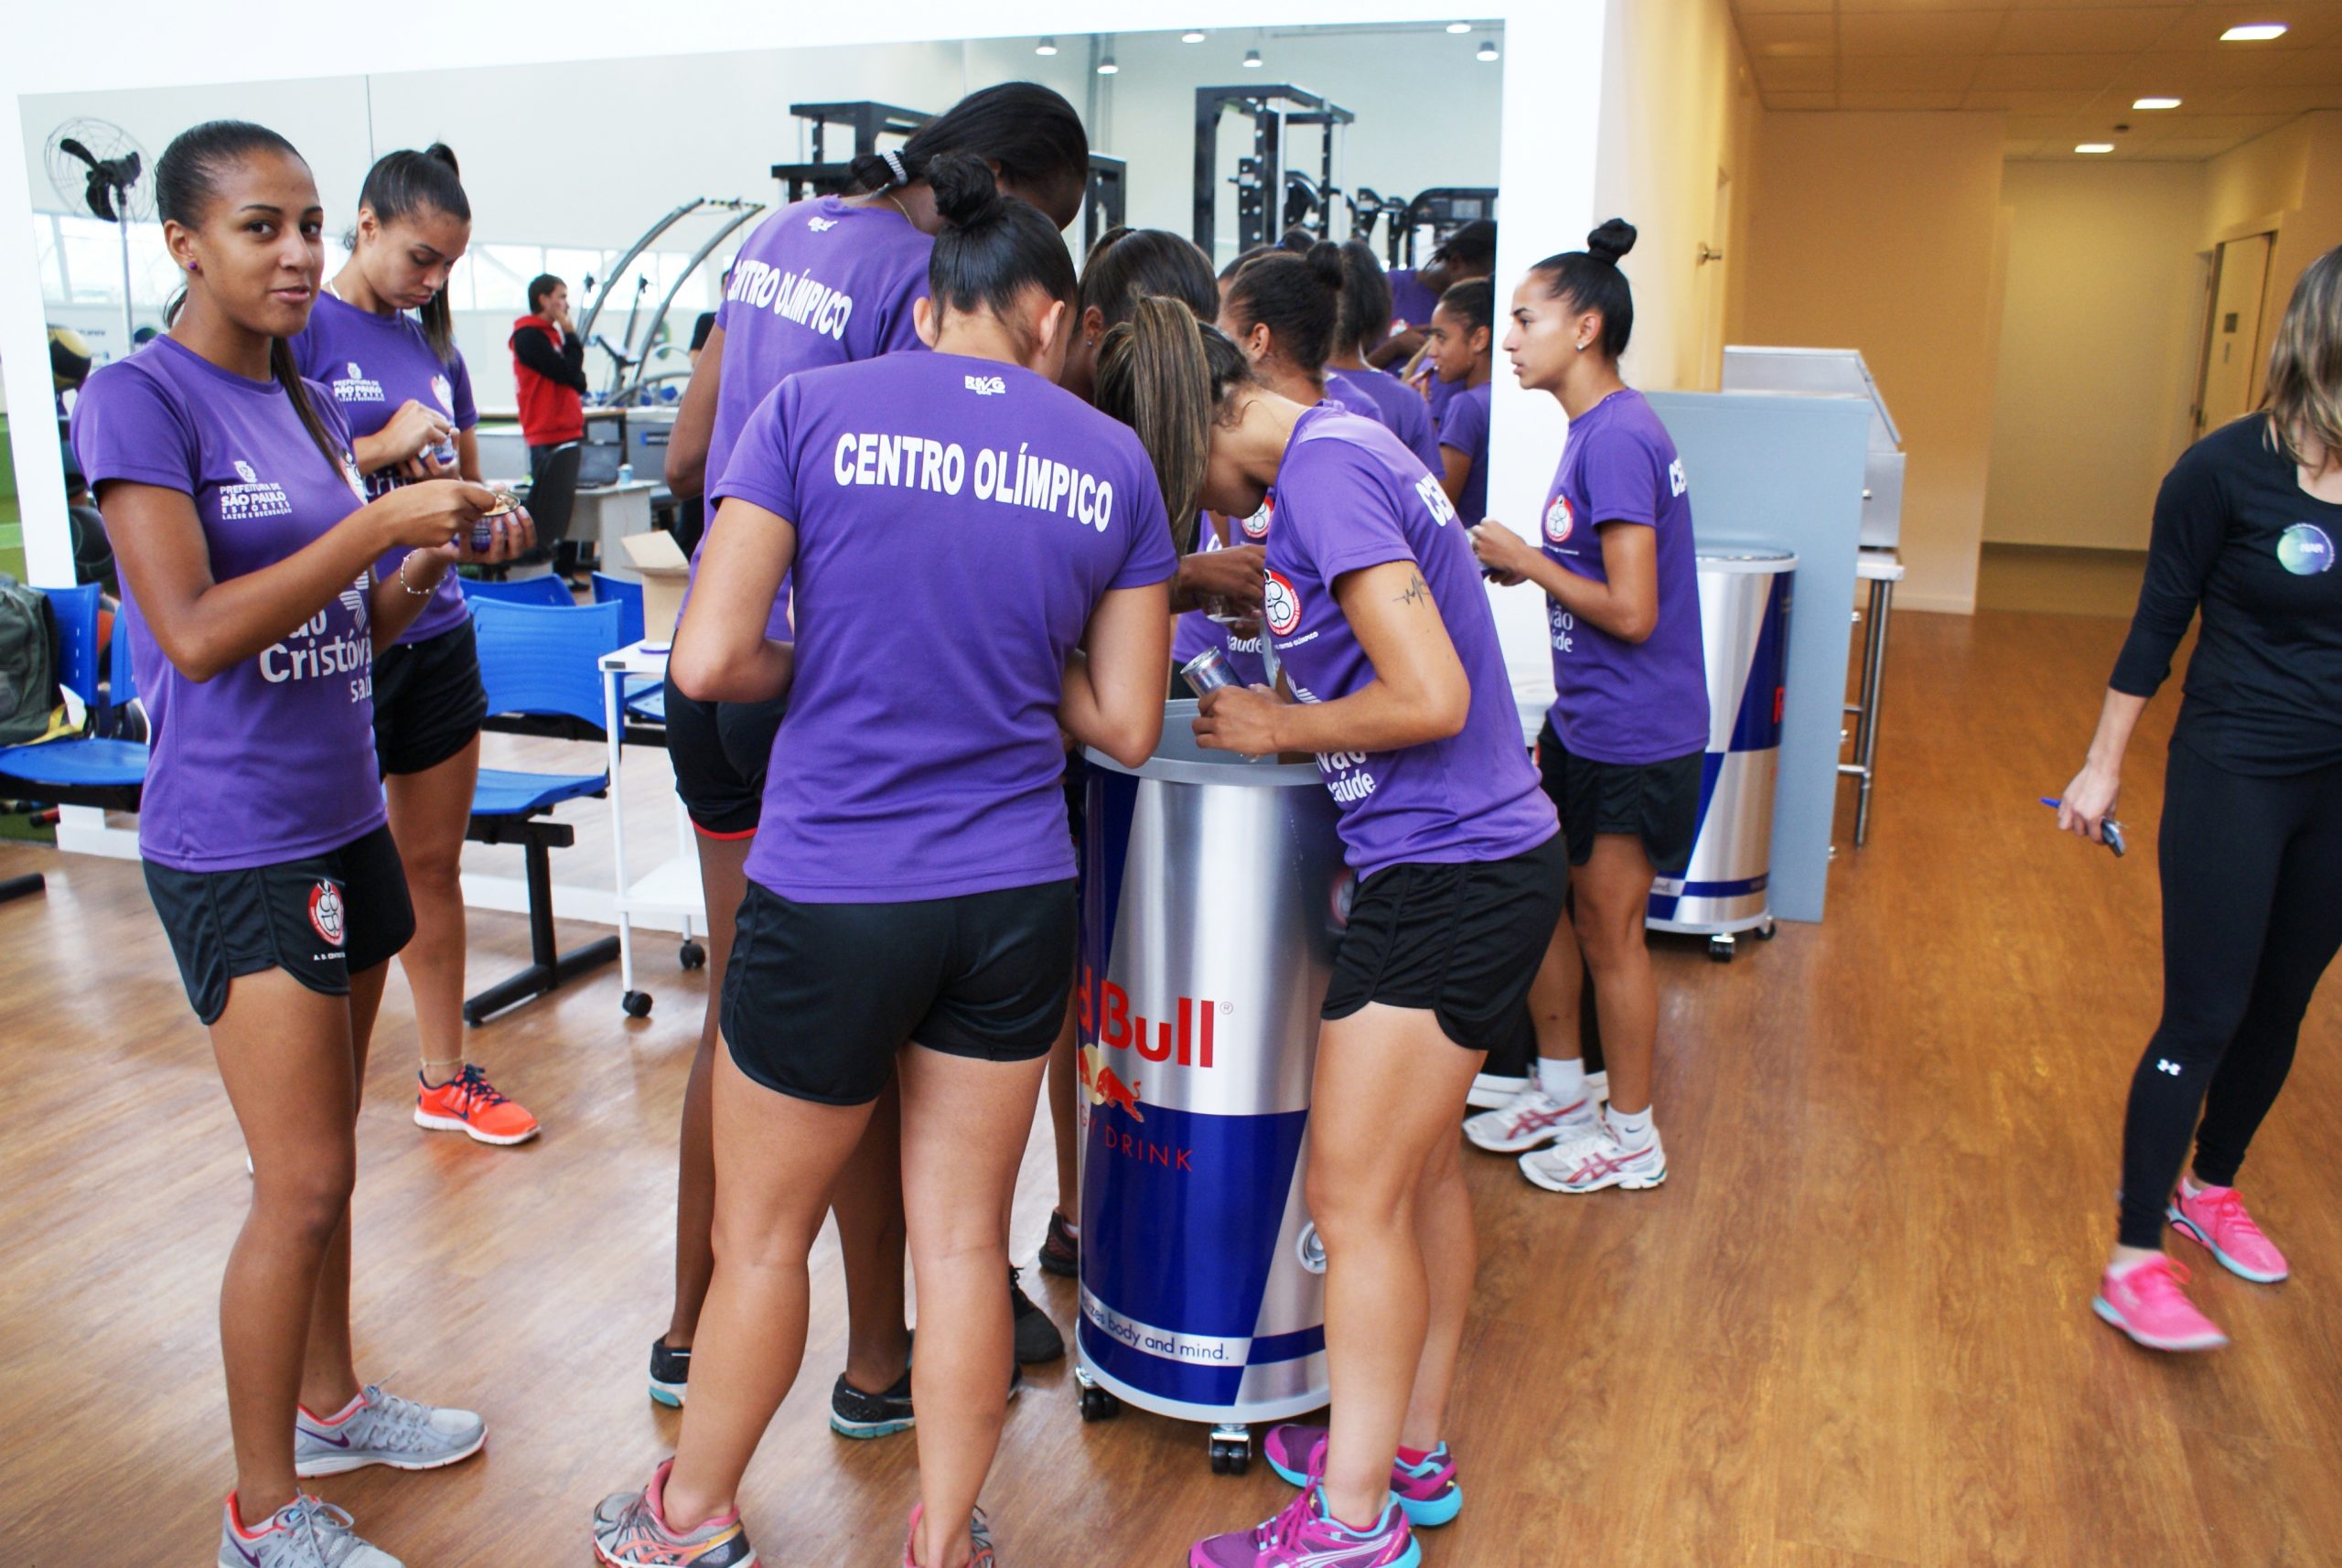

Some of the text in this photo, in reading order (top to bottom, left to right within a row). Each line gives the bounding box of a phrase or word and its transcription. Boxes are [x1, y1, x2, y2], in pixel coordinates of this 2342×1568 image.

[774, 268, 853, 340] OLÍMPICO
[220, 483, 272, 495] PREFEITURA
[220, 490, 287, 507] SÃO PAULO
[833, 432, 1113, 532] CENTRO OLÍMPICO
[1100, 979, 1215, 1069] Bull
[1104, 1125, 1193, 1172] DRINK
[1108, 1311, 1141, 1347] body
[1144, 1337, 1176, 1355] and
[1179, 1342, 1230, 1361] mind.
